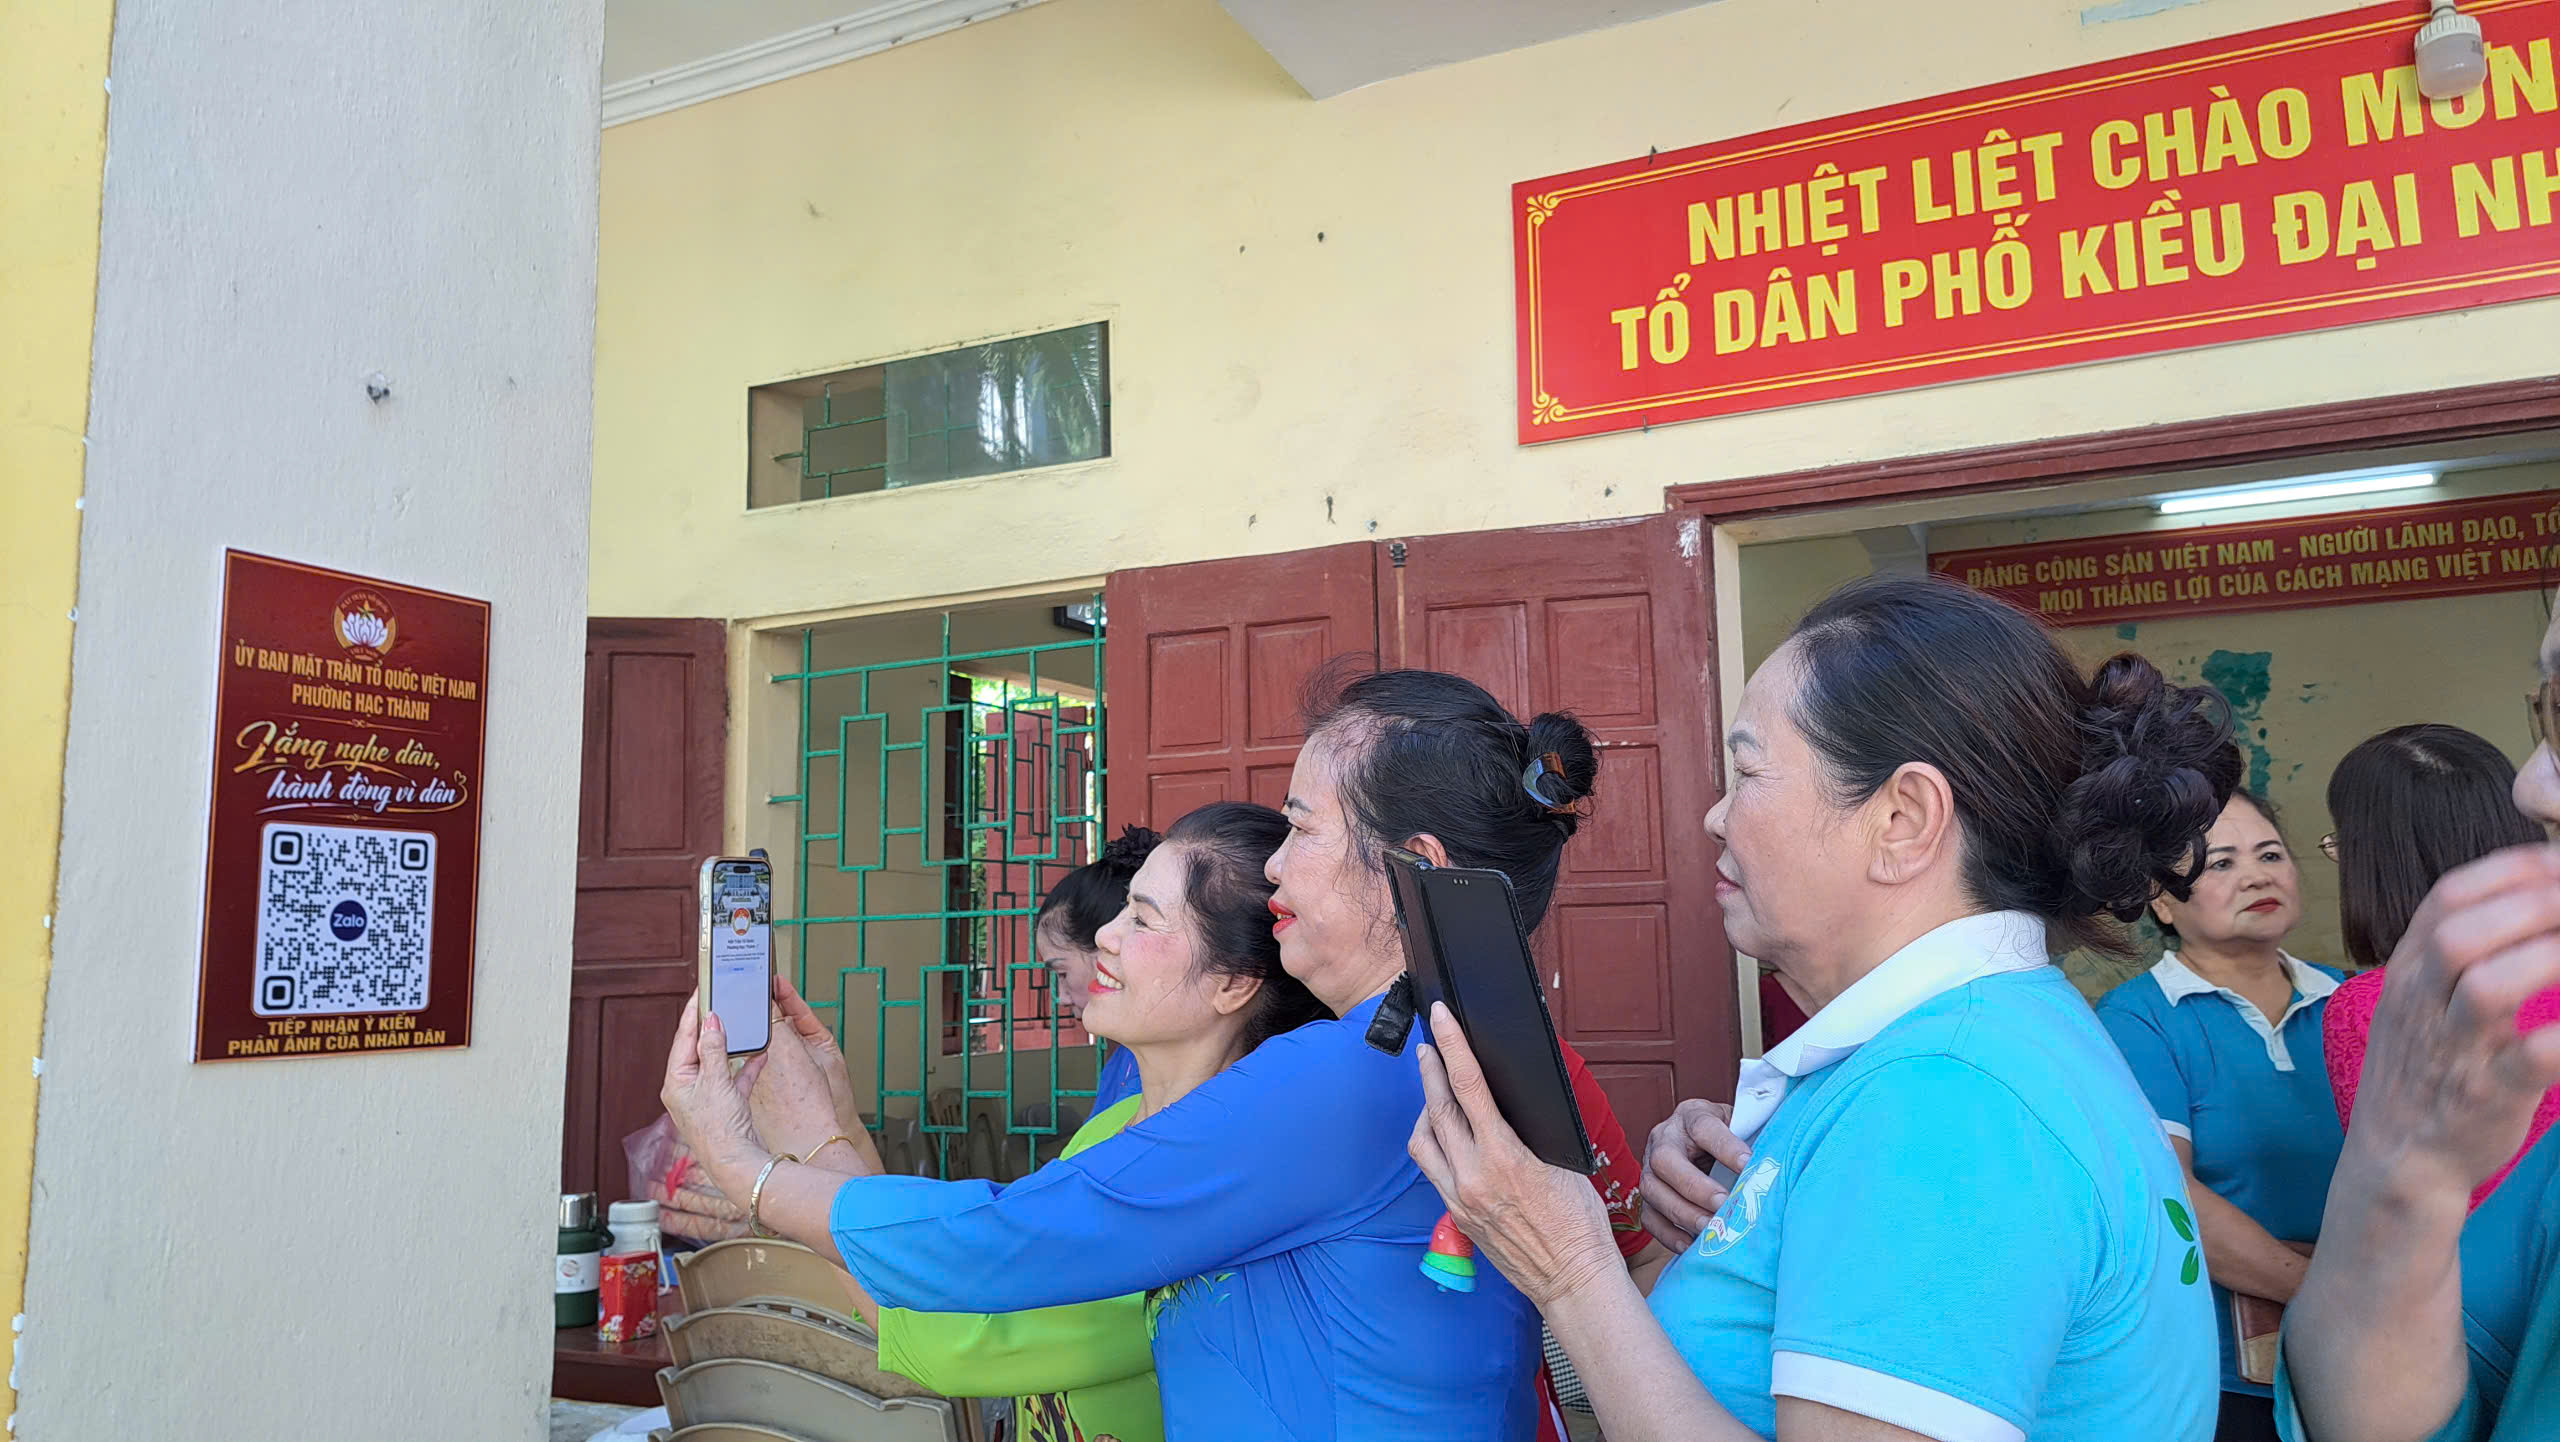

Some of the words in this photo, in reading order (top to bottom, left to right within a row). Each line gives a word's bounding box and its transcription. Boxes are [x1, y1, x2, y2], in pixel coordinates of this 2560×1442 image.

[1687, 162, 1888, 266] NHIỆT
[1911, 128, 2064, 226] LIỆT
[2090, 86, 2313, 190] CHÀO
[1610, 272, 1692, 371] TỔ
[1713, 266, 1859, 355] DÂN
[1881, 213, 2034, 328] PHỐ
[2059, 190, 2246, 300] KIỀU
[2272, 172, 2423, 271] ĐẠI
[1966, 560, 2029, 589] ĐẢNG
[2035, 555, 2098, 586] CỘNG
[2105, 546, 2152, 576] SẢN
[2159, 542, 2210, 573] VIỆT
[2217, 539, 2275, 566] NAM
[2299, 525, 2379, 558] NGƯỜI
[2385, 521, 2455, 550] LÃNH
[2462, 515, 2524, 546] ĐẠO,
[2039, 587, 2084, 615] MỌI
[2089, 576, 2168, 607] THẮNG
[2174, 574, 2212, 605] LỢI
[2219, 566, 2270, 597] CỦA
[2275, 562, 2343, 592] CÁCH
[2351, 557, 2429, 588] MẠNG
[2435, 549, 2493, 581] VIỆT
[235, 639, 256, 667] ỦY
[258, 649, 288, 674] BAN
[292, 652, 322, 681] MẶT
[326, 658, 362, 685] TRẬN
[366, 658, 384, 687] TỔ
[385, 666, 418, 691] QUỐC
[422, 674, 446, 699] VIỆT
[449, 681, 477, 700] NAM
[292, 684, 352, 711] PHƯỜNG
[355, 694, 383, 719] HẠC
[387, 694, 430, 721] THÀNH
[233, 720, 328, 774] Lắng
[335, 734, 390, 771] nghe
[395, 738, 441, 769] dân,
[267, 769, 333, 800] hành
[339, 770, 391, 813] động
[396, 778, 416, 802] vì
[419, 777, 457, 803] dân
[333, 913, 365, 928] Zalo
[228, 1034, 279, 1055] PHẢN
[325, 1030, 359, 1050] CỦA
[364, 1028, 409, 1047] NHÂN
[414, 1028, 446, 1045] DÂN
[267, 1016, 307, 1036] TIẾP
[311, 1016, 359, 1034] NHẬN
[379, 1011, 416, 1030] KIẾN
